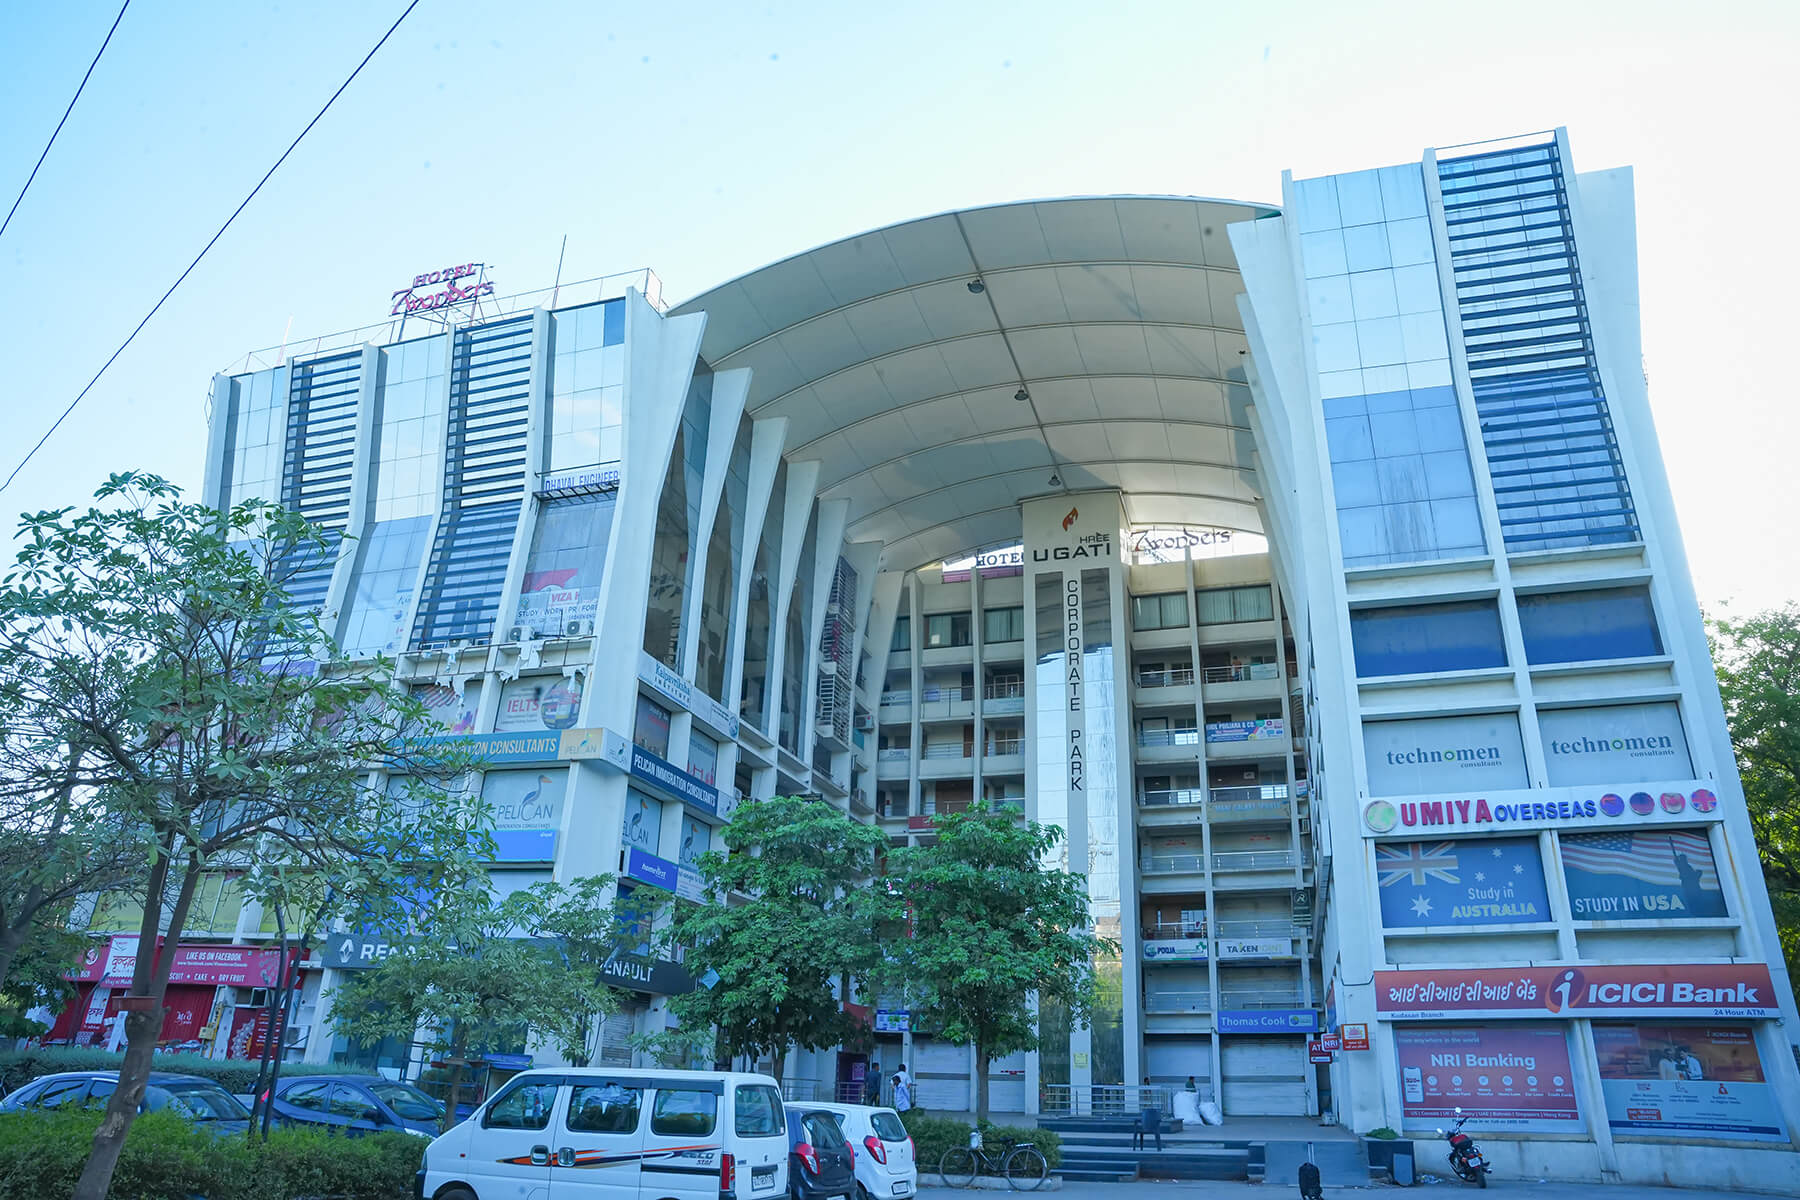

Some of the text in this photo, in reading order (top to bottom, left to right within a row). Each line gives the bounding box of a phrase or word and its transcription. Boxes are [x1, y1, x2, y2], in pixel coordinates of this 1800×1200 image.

[413, 263, 476, 288] HOTEL
[1033, 543, 1111, 562] UGATI
[1066, 579, 1082, 792] CORPORATE PARK
[507, 699, 539, 713] IELTS
[490, 737, 557, 755] CONSULTANTS
[1552, 733, 1672, 755] technomen
[1630, 748, 1675, 758] consultants
[1386, 744, 1500, 766] technomen
[633, 754, 656, 776] PELICAN
[1460, 760, 1503, 769] consultants
[497, 803, 554, 821] PELICAN
[1400, 799, 1598, 827] UMIYA OVERSEAS
[1467, 886, 1514, 902] Study in
[1451, 902, 1537, 919] AUSTRALIA
[1575, 894, 1685, 913] STUDY IN USA
[1588, 983, 1760, 1003] ICICI Bank
[1221, 1016, 1286, 1026] Thomas Cook
[1746, 1009, 1766, 1017] ATM
[1431, 1053, 1537, 1071] NRI Banking
